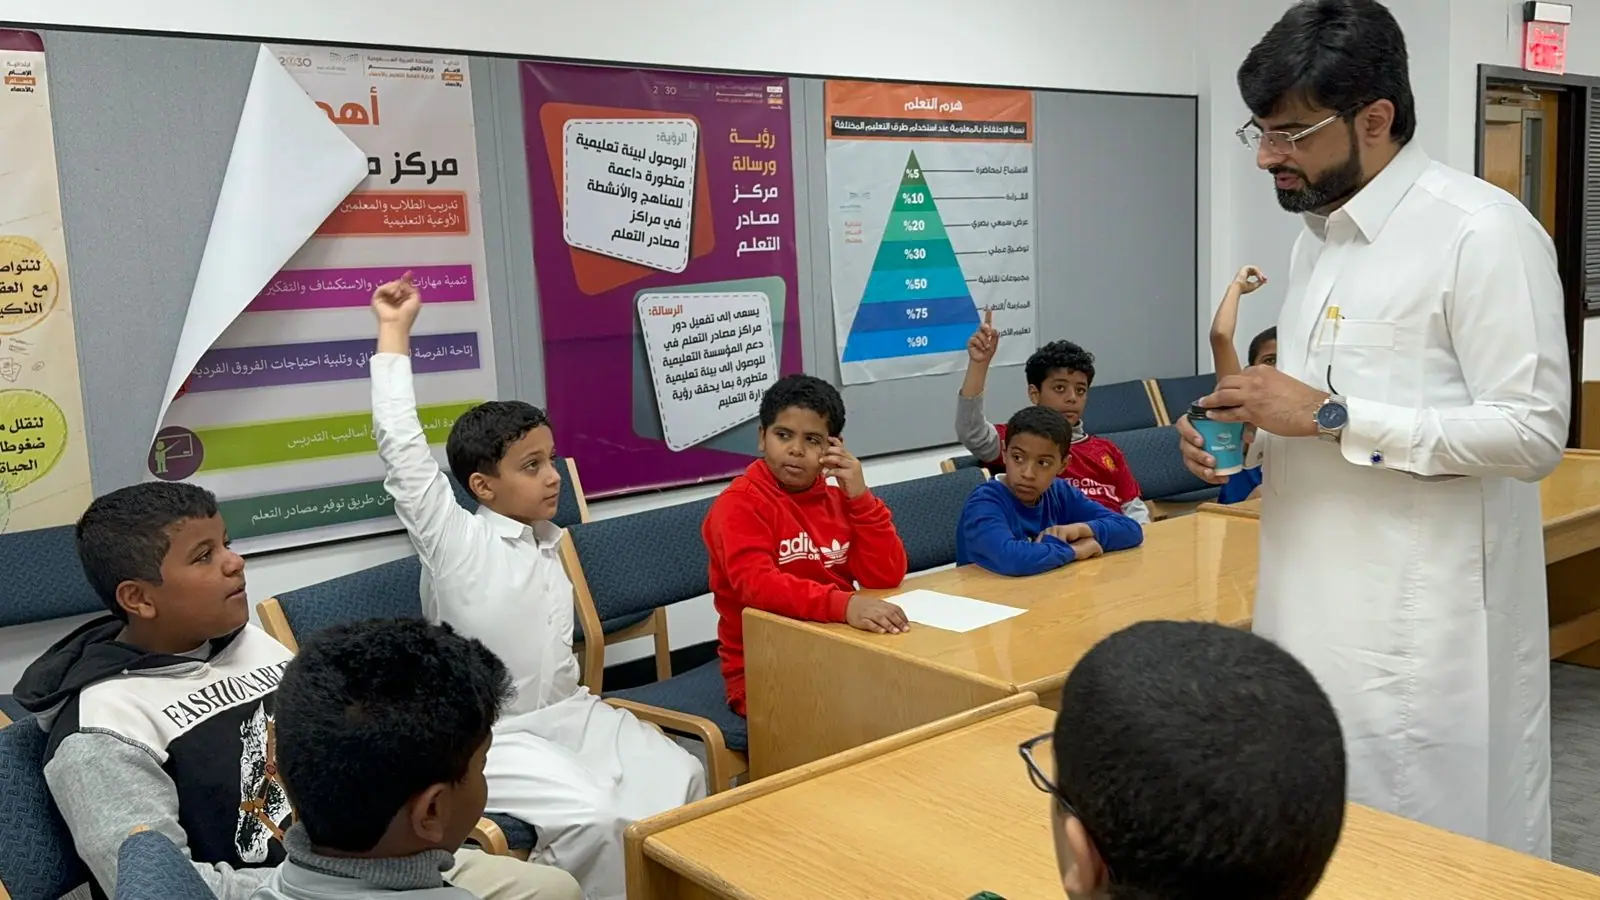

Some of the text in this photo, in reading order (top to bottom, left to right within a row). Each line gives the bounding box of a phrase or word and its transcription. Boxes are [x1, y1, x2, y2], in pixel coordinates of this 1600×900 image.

[904, 96, 963, 112] هرم التعلم
[834, 120, 865, 131] المختلفة
[865, 122, 890, 132] التعليم
[891, 122, 908, 133] طرق
[909, 122, 937, 132] استخدام
[950, 124, 982, 134] بالمعلومة
[1010, 124, 1025, 134] نسبة
[656, 131, 688, 146] الرؤية:
[729, 127, 776, 149] رؤية
[576, 132, 687, 170] الوصول لبيئة تعليمية
[390, 151, 458, 184] مركز
[732, 155, 777, 177] ورسالة
[906, 168, 920, 179] %5
[608, 162, 685, 189] متطورة داعمة
[587, 178, 684, 208] للمناهج والأنشطة
[732, 183, 778, 204] مركز
[902, 192, 924, 204] %10
[340, 198, 458, 213] تدريب الطلاب والمعلمين
[383, 212, 460, 228] الأوعية التعليمية
[629, 210, 682, 230] في مراكز
[735, 210, 780, 230] مصادر
[903, 220, 926, 232] %20
[611, 228, 680, 249] مصادر التعلم
[736, 236, 780, 258] التعلم
[904, 248, 926, 260] %30
[0, 258, 41, 276] لنتواص
[264, 280, 306, 296] والتفكير
[309, 277, 372, 292] والاستكشاف
[410, 277, 442, 290] مهارات
[444, 274, 468, 287] تنمية
[905, 278, 928, 290] %50
[0, 281, 48, 298] مع العق
[0, 301, 43, 318] الذكي
[648, 304, 683, 318] الرسالة:
[906, 308, 928, 320] %75
[672, 308, 760, 334] يسعى إلى تفعيل دور
[663, 324, 762, 352] مراكز مصادر التعلم في
[906, 336, 928, 348] %90
[414, 348, 448, 361] الفرصة
[449, 345, 474, 358] إتاحة
[662, 340, 764, 368] دعم المؤسسة التعليمية
[232, 360, 268, 376] الفروق
[270, 356, 321, 370] احتياجات
[324, 354, 353, 368] وتلبية
[665, 355, 766, 385] للوصول إلى بيئة تعليمية
[672, 372, 768, 402] متطورة بما يحقق رؤية
[718, 389, 766, 410] زارة التعليم
[287, 430, 328, 448] التدريس
[331, 424, 368, 442] أساليب
[0, 437, 46, 454] ضغوطا
[251, 493, 393, 526] عن طريق توفير مصادر التعلم
[778, 532, 820, 557] adi
